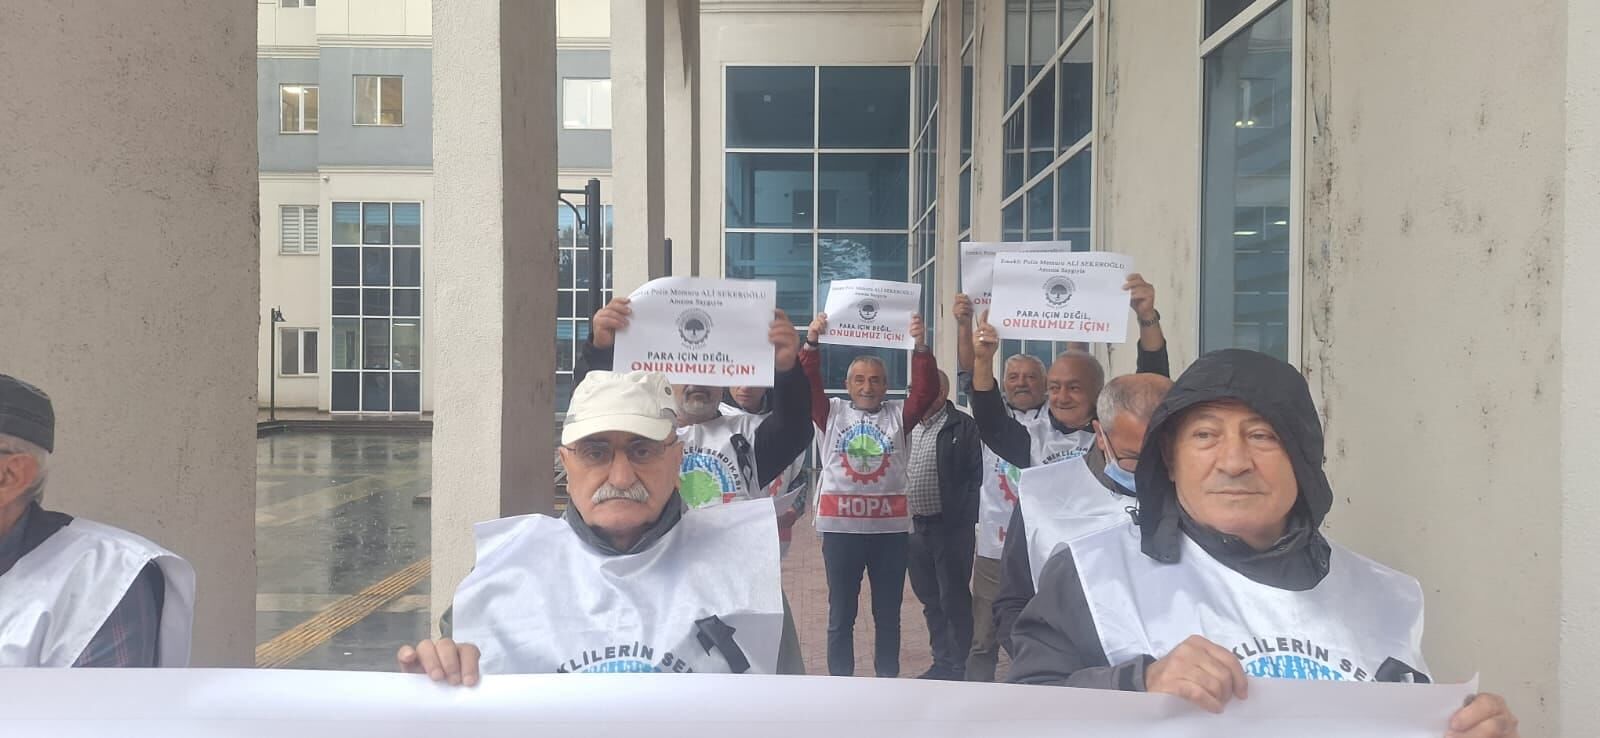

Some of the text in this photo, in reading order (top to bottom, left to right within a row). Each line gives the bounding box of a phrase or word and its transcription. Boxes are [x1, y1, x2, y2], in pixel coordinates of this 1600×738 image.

[1016, 310, 1039, 318] PARA
[1042, 311, 1060, 319] İÇİN
[1003, 318, 1110, 332] ONURUMUZ İÇİN!
[829, 329, 881, 339] ONURUMUZ
[647, 351, 674, 361] PARA
[677, 352, 698, 362] İÇİN
[631, 361, 756, 376] ONURUMUZ İÇİN!
[837, 495, 893, 516] HOPA
